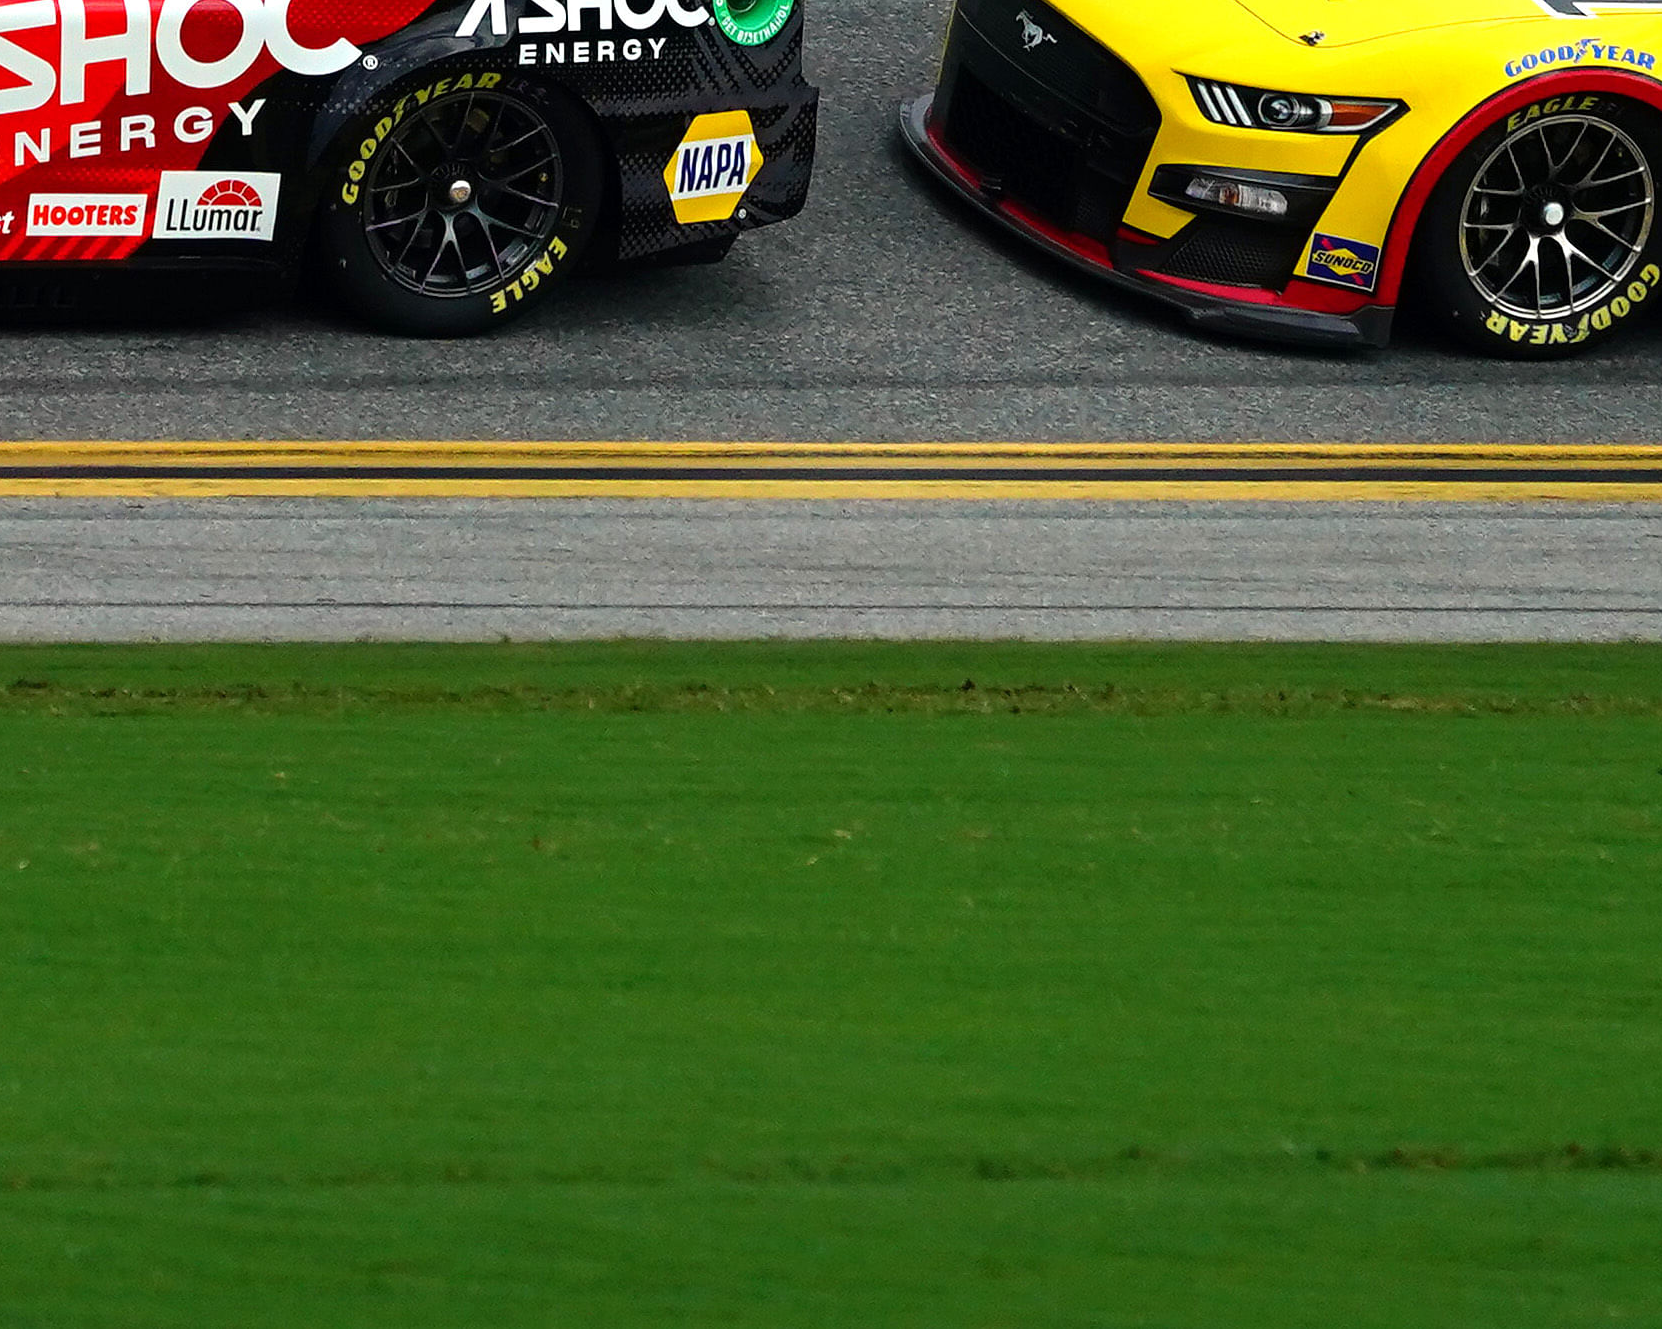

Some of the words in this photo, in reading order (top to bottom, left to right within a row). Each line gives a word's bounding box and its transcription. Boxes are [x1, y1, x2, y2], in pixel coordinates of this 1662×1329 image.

[517, 37, 668, 65] ENERGY
[1504, 37, 1656, 78] GOODYEAR
[1506, 95, 1601, 133] EAGLE
[341, 72, 502, 205] GOODYEAR
[678, 140, 746, 193] NAPA
[32, 204, 140, 228] HOOTERS
[165, 197, 264, 233] LLumar
[489, 235, 568, 314] EAGLE
[1314, 251, 1372, 273] SUNOCO
[1485, 262, 1661, 345] GOODYEAR
